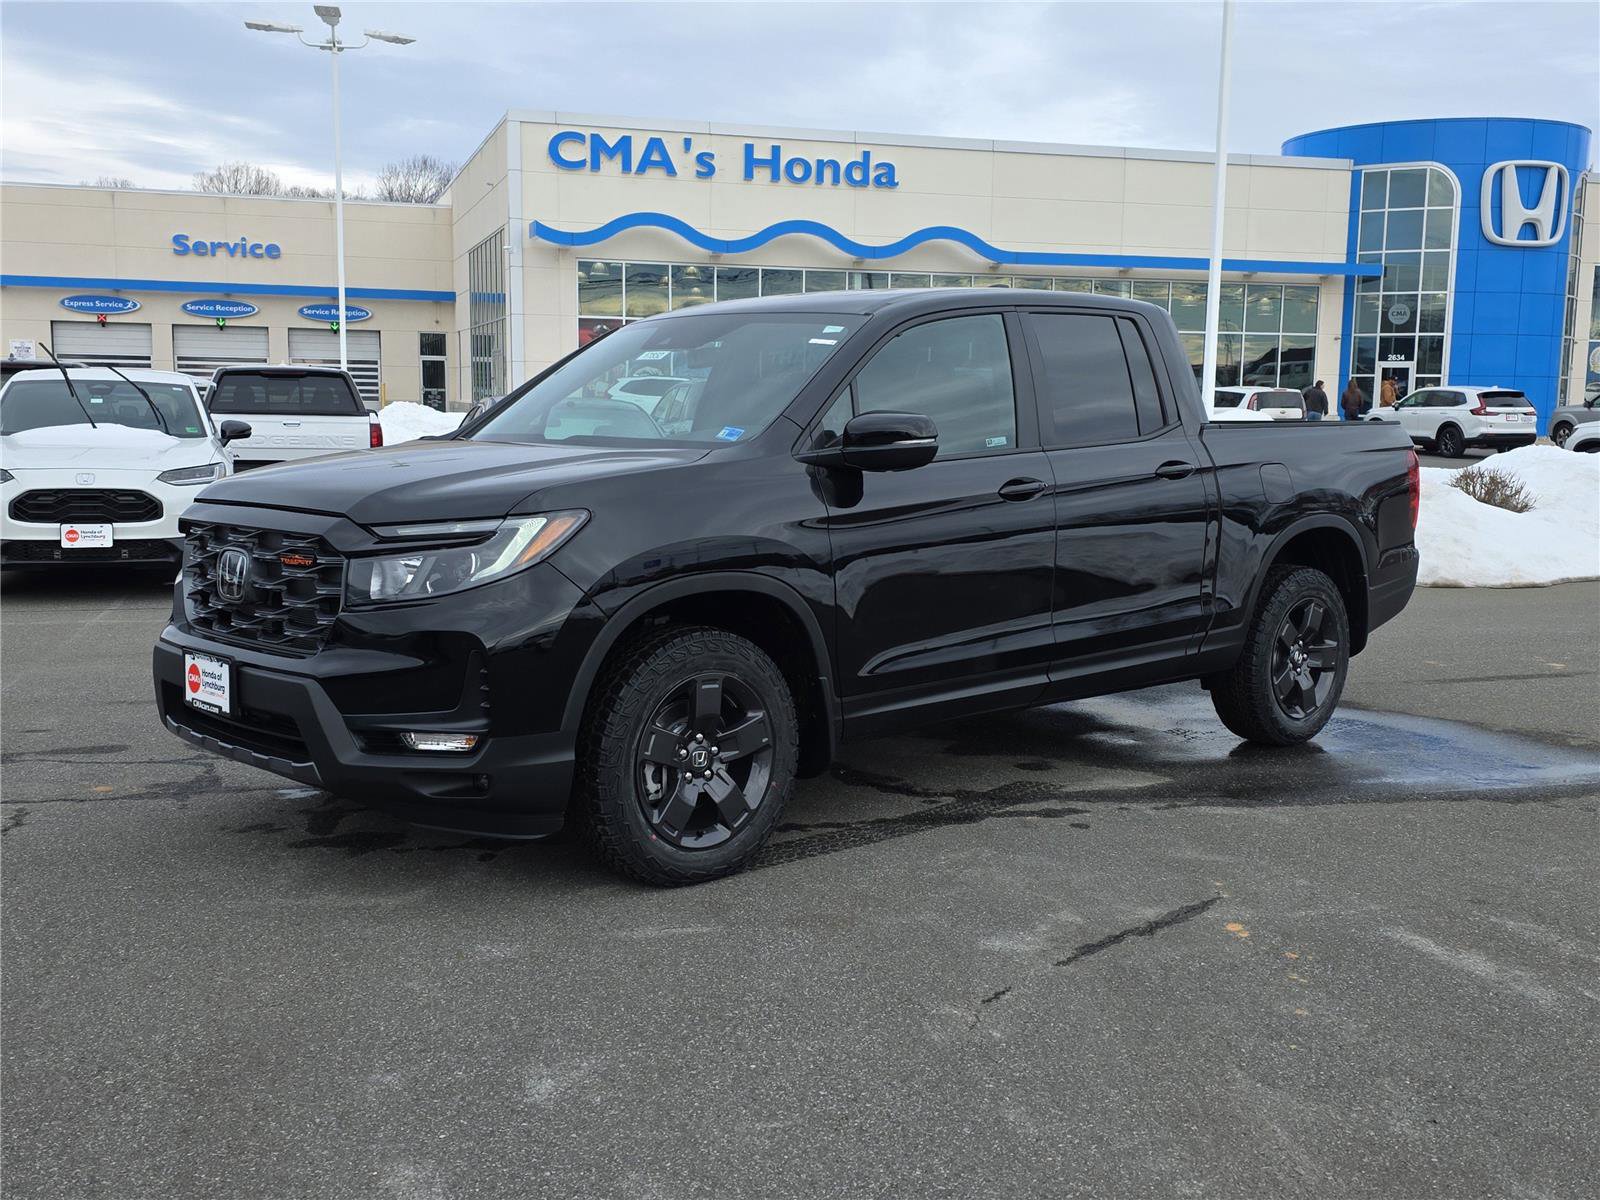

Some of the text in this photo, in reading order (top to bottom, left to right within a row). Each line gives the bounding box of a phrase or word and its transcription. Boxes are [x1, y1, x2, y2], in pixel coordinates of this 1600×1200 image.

[548, 131, 899, 188] CMA's Honda
[172, 234, 281, 259] Service
[64, 300, 94, 308] Express
[216, 304, 253, 313] Reception
[331, 308, 367, 317] Reeption
[202, 669, 223, 681] Honda of
[202, 678, 226, 694] Lynchburg
